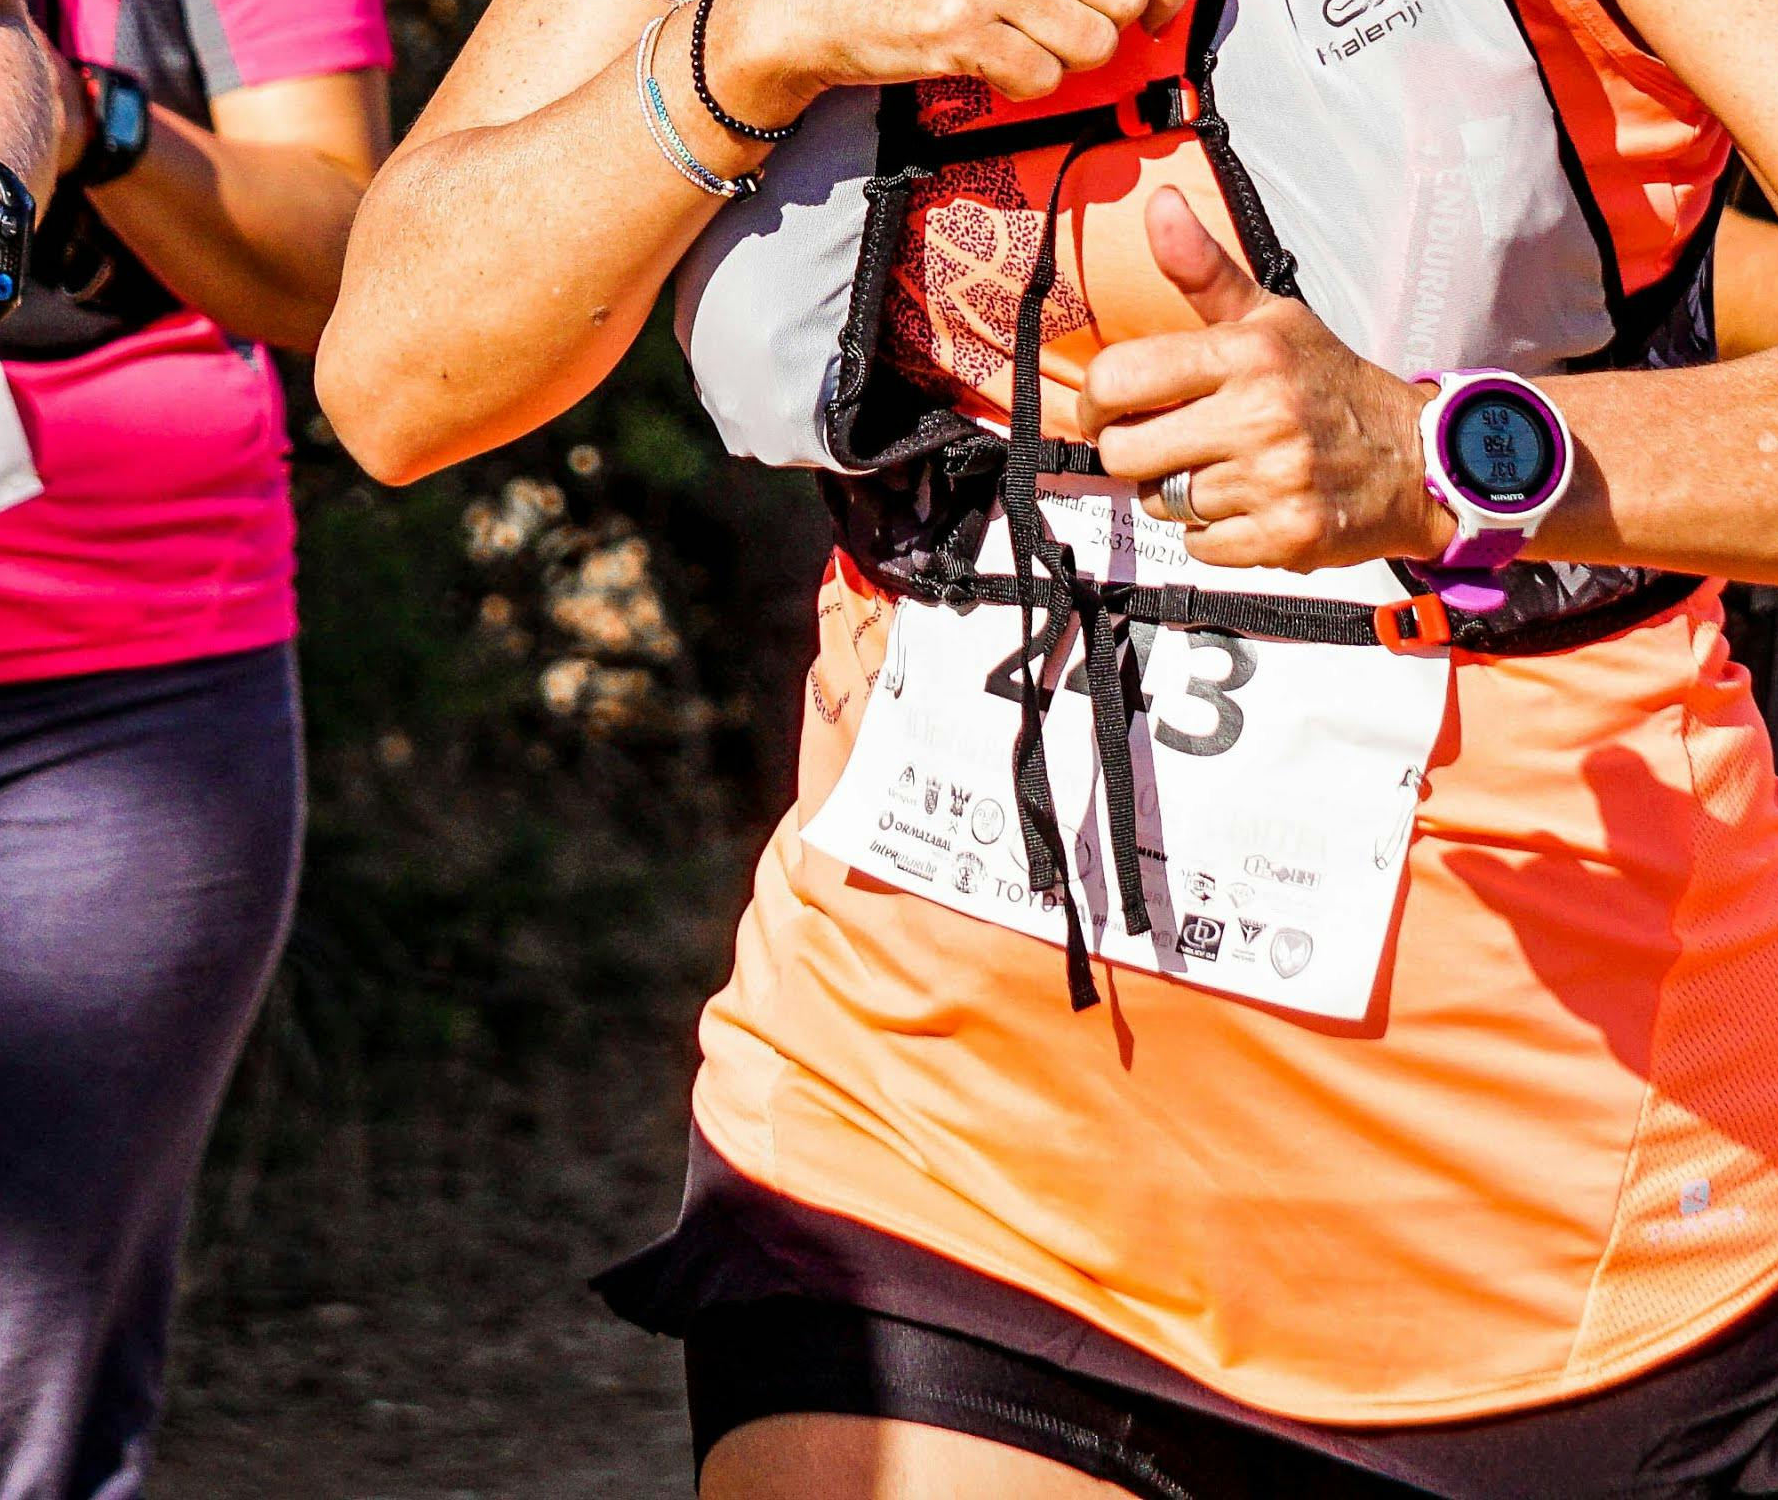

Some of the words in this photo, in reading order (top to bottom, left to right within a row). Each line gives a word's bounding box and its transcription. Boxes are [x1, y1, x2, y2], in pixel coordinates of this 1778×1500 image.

[1033, 487, 1088, 513] ontatar
[1091, 503, 1116, 522] em
[1121, 512, 1160, 534] caso
[1089, 527, 1189, 568] 263740219
